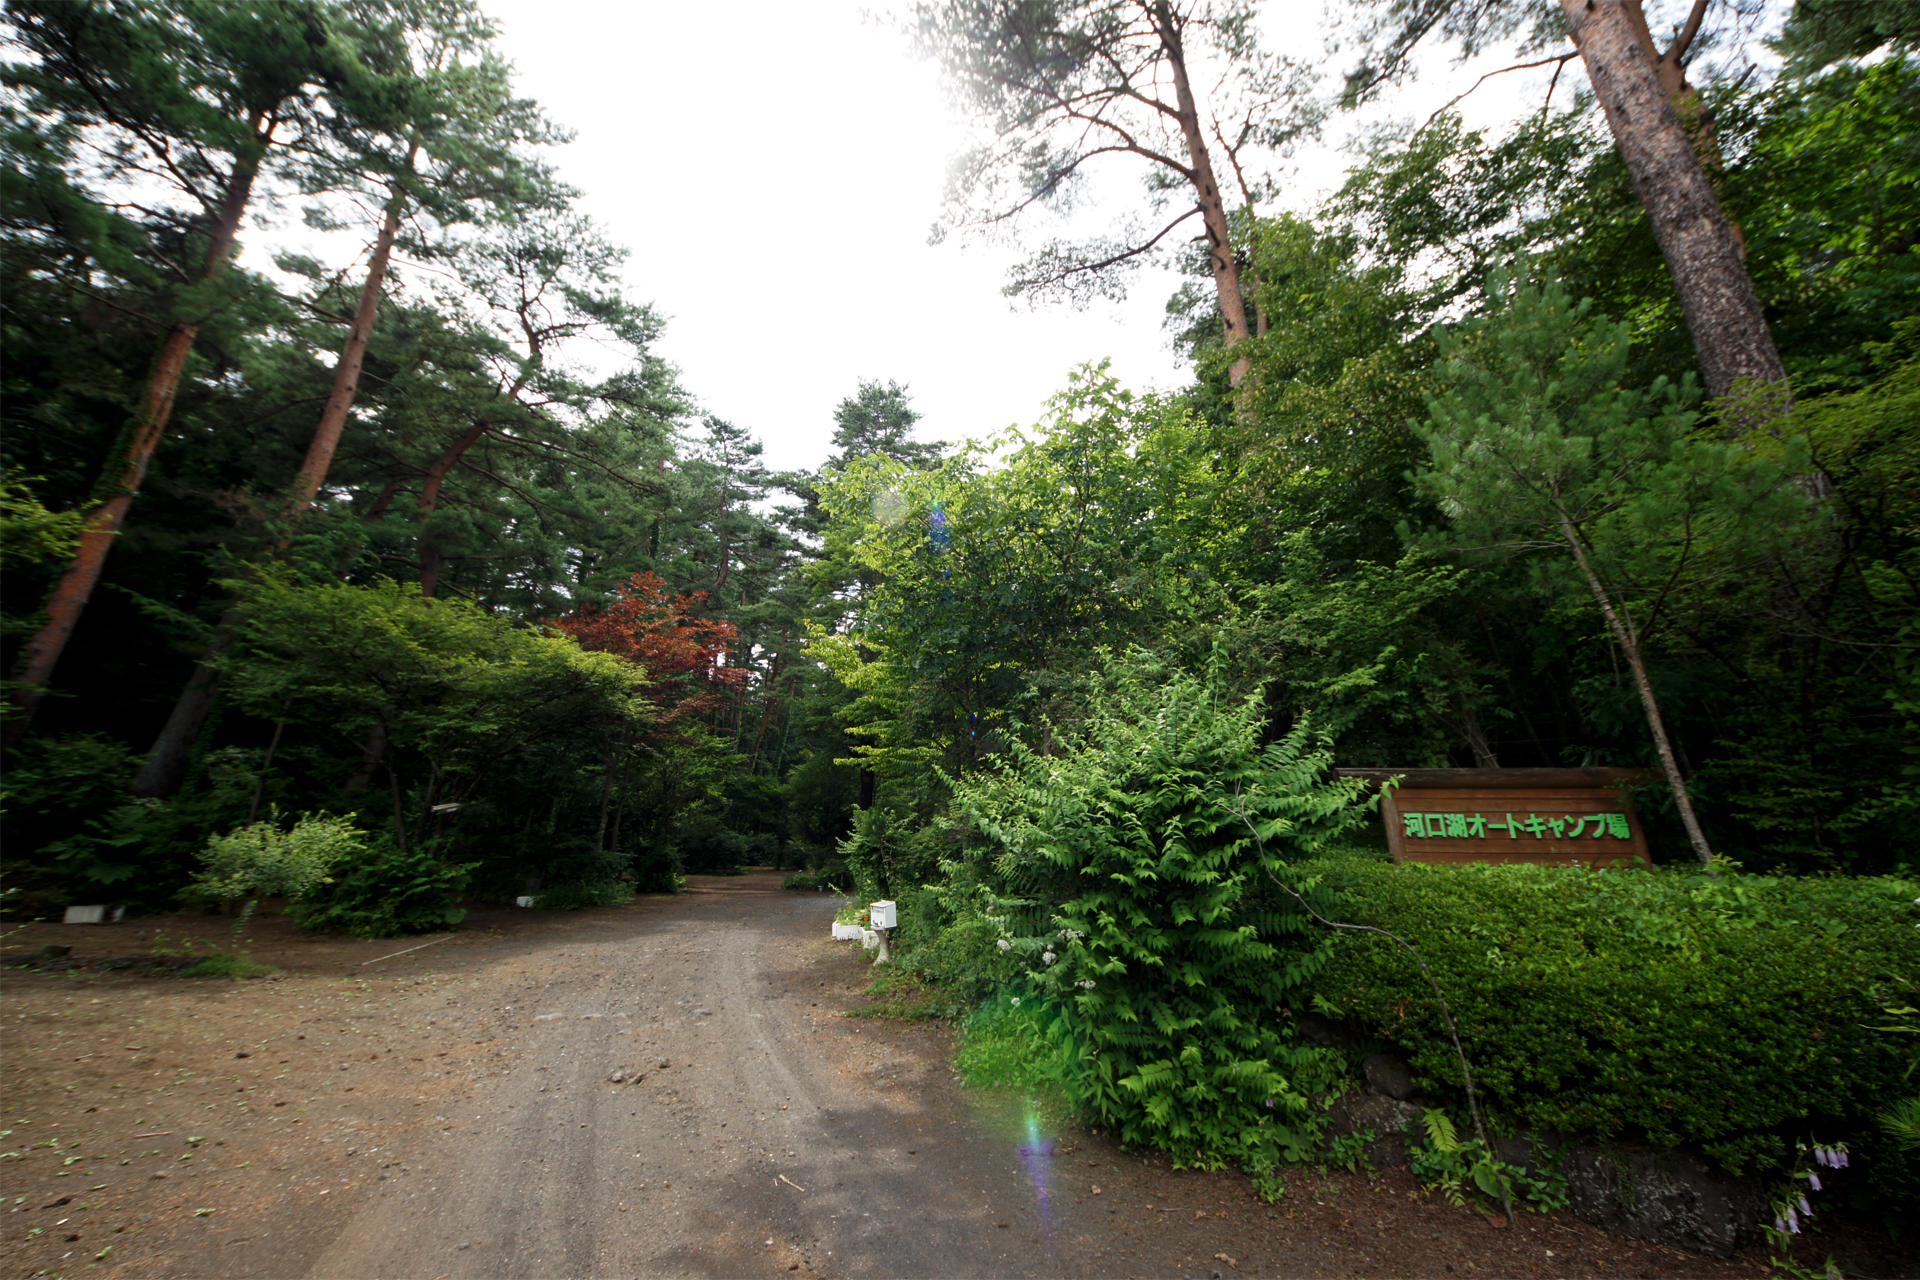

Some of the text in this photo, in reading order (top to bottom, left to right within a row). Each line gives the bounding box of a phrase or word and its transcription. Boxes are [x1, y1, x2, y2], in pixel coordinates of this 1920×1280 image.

[1403, 813, 1630, 839] 河口湖オートキャンプ場
